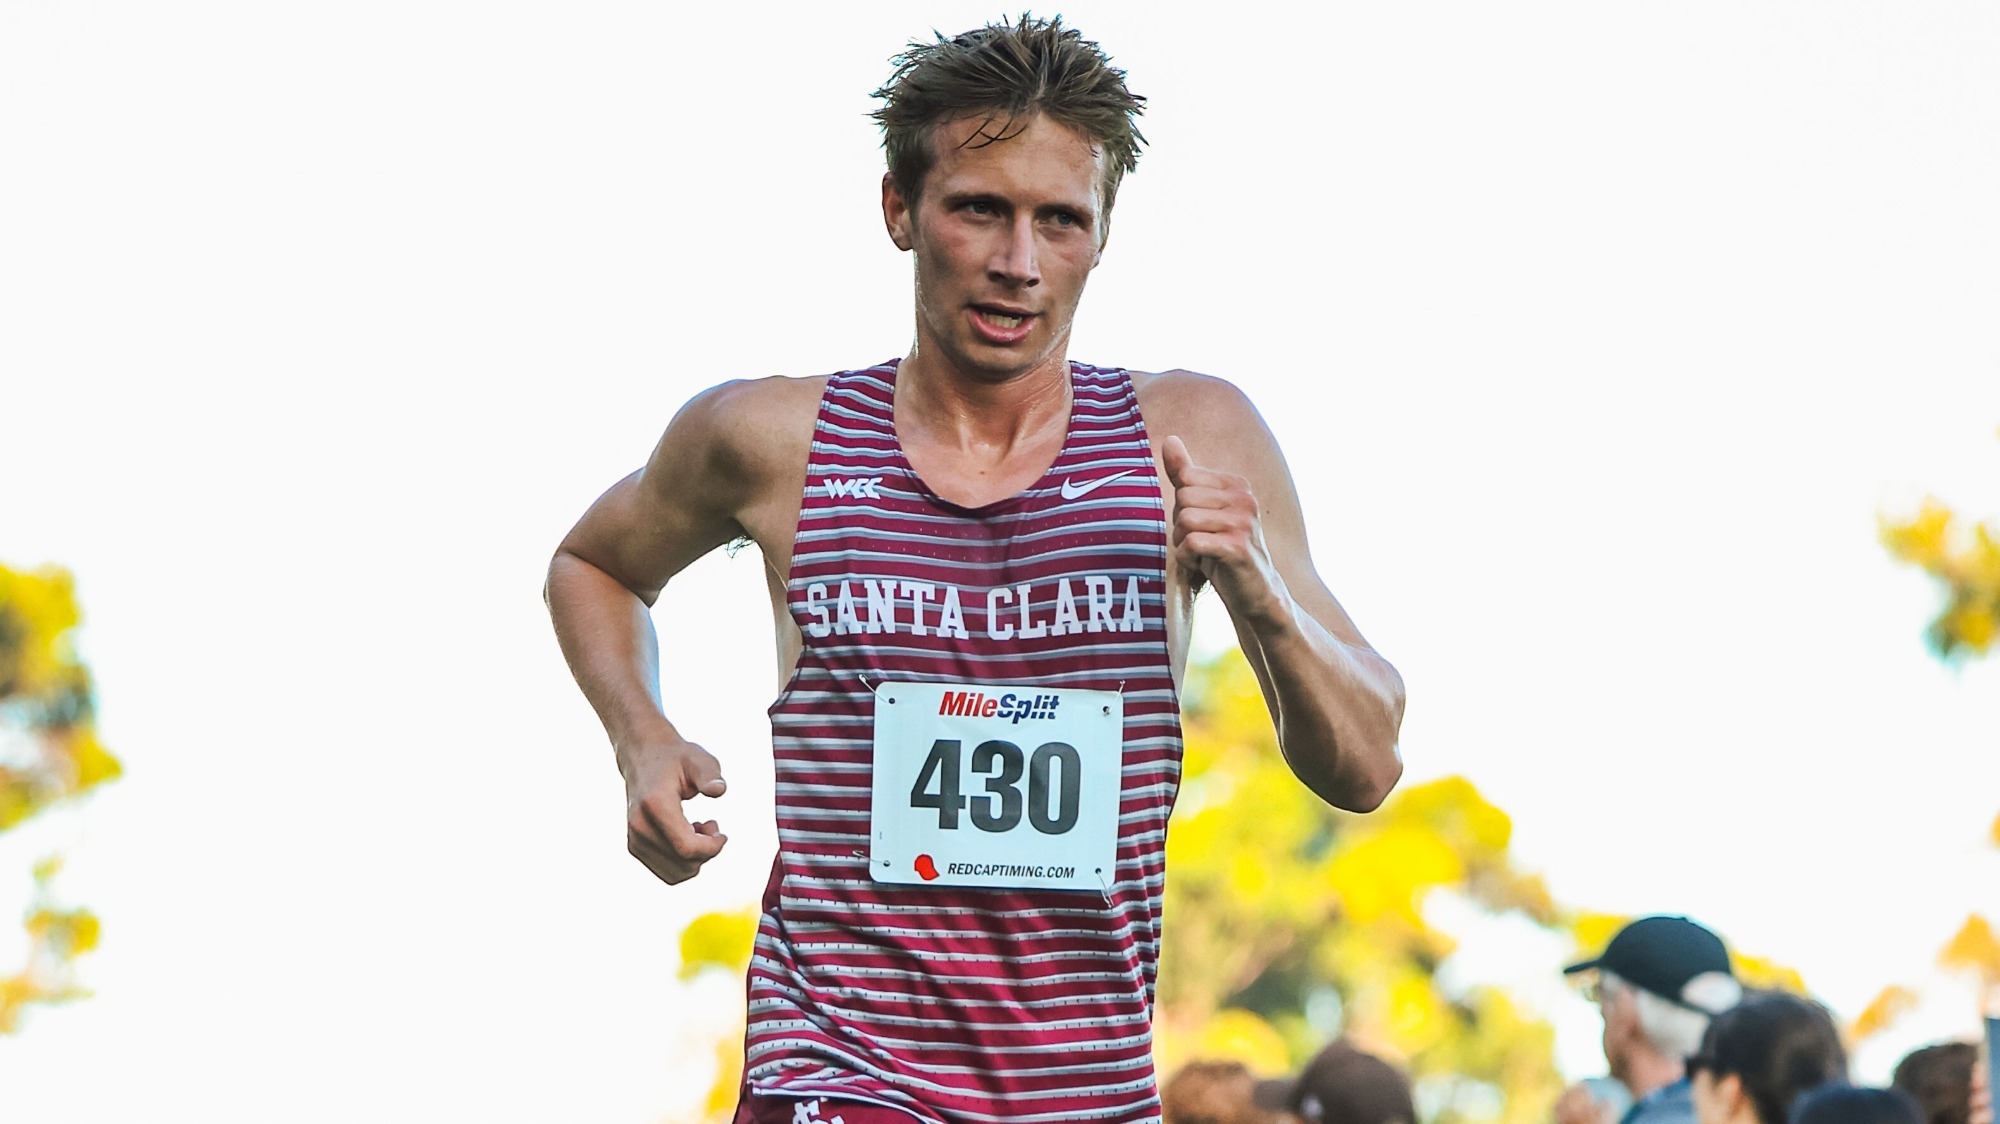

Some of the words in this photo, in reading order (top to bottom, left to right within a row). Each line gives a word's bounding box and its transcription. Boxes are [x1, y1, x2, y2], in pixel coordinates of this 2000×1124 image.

[806, 578, 970, 641] SANTA
[986, 574, 1144, 641] CLARA
[938, 690, 1060, 725] MileSplit
[910, 738, 1082, 836] 430
[947, 862, 1076, 879] REDCAPTIMING.COM
